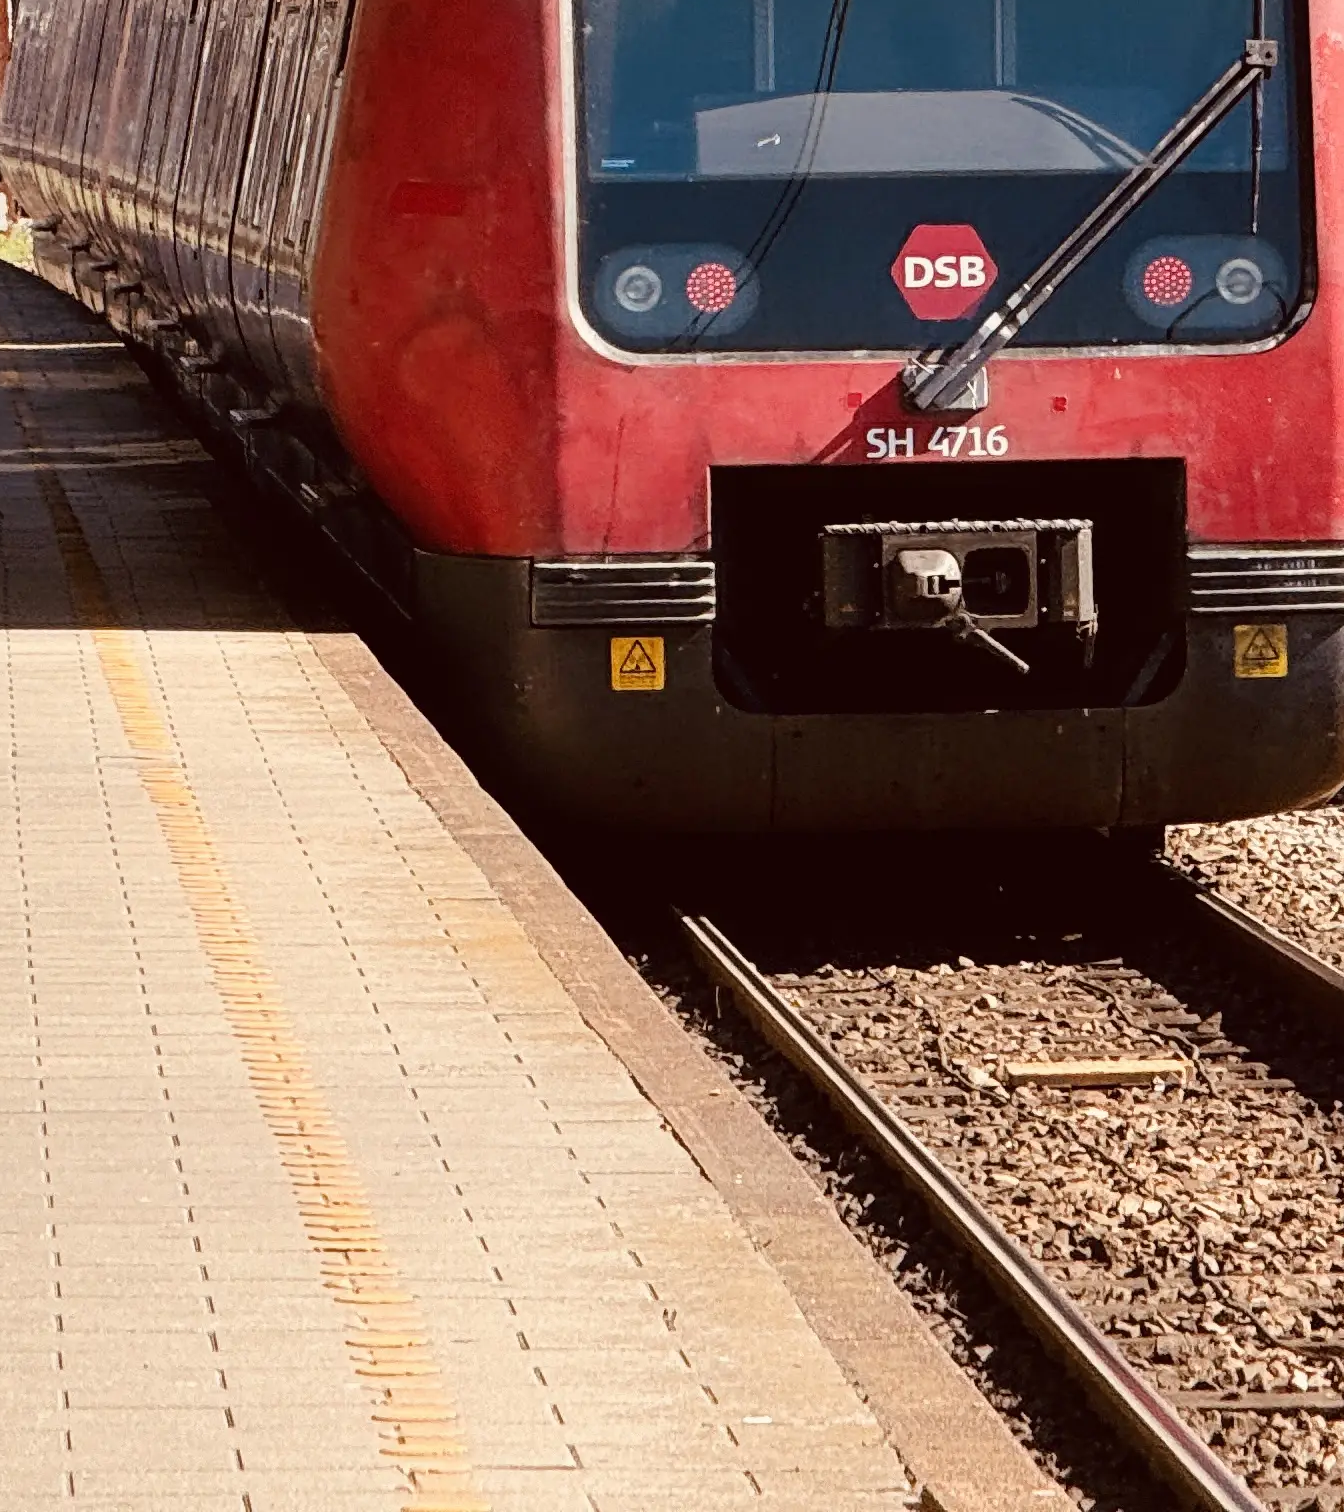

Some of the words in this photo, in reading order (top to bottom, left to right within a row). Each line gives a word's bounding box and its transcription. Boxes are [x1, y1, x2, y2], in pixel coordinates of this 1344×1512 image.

[904, 256, 986, 288] DSB
[866, 427, 914, 458] SH
[927, 425, 1009, 458] 4716
